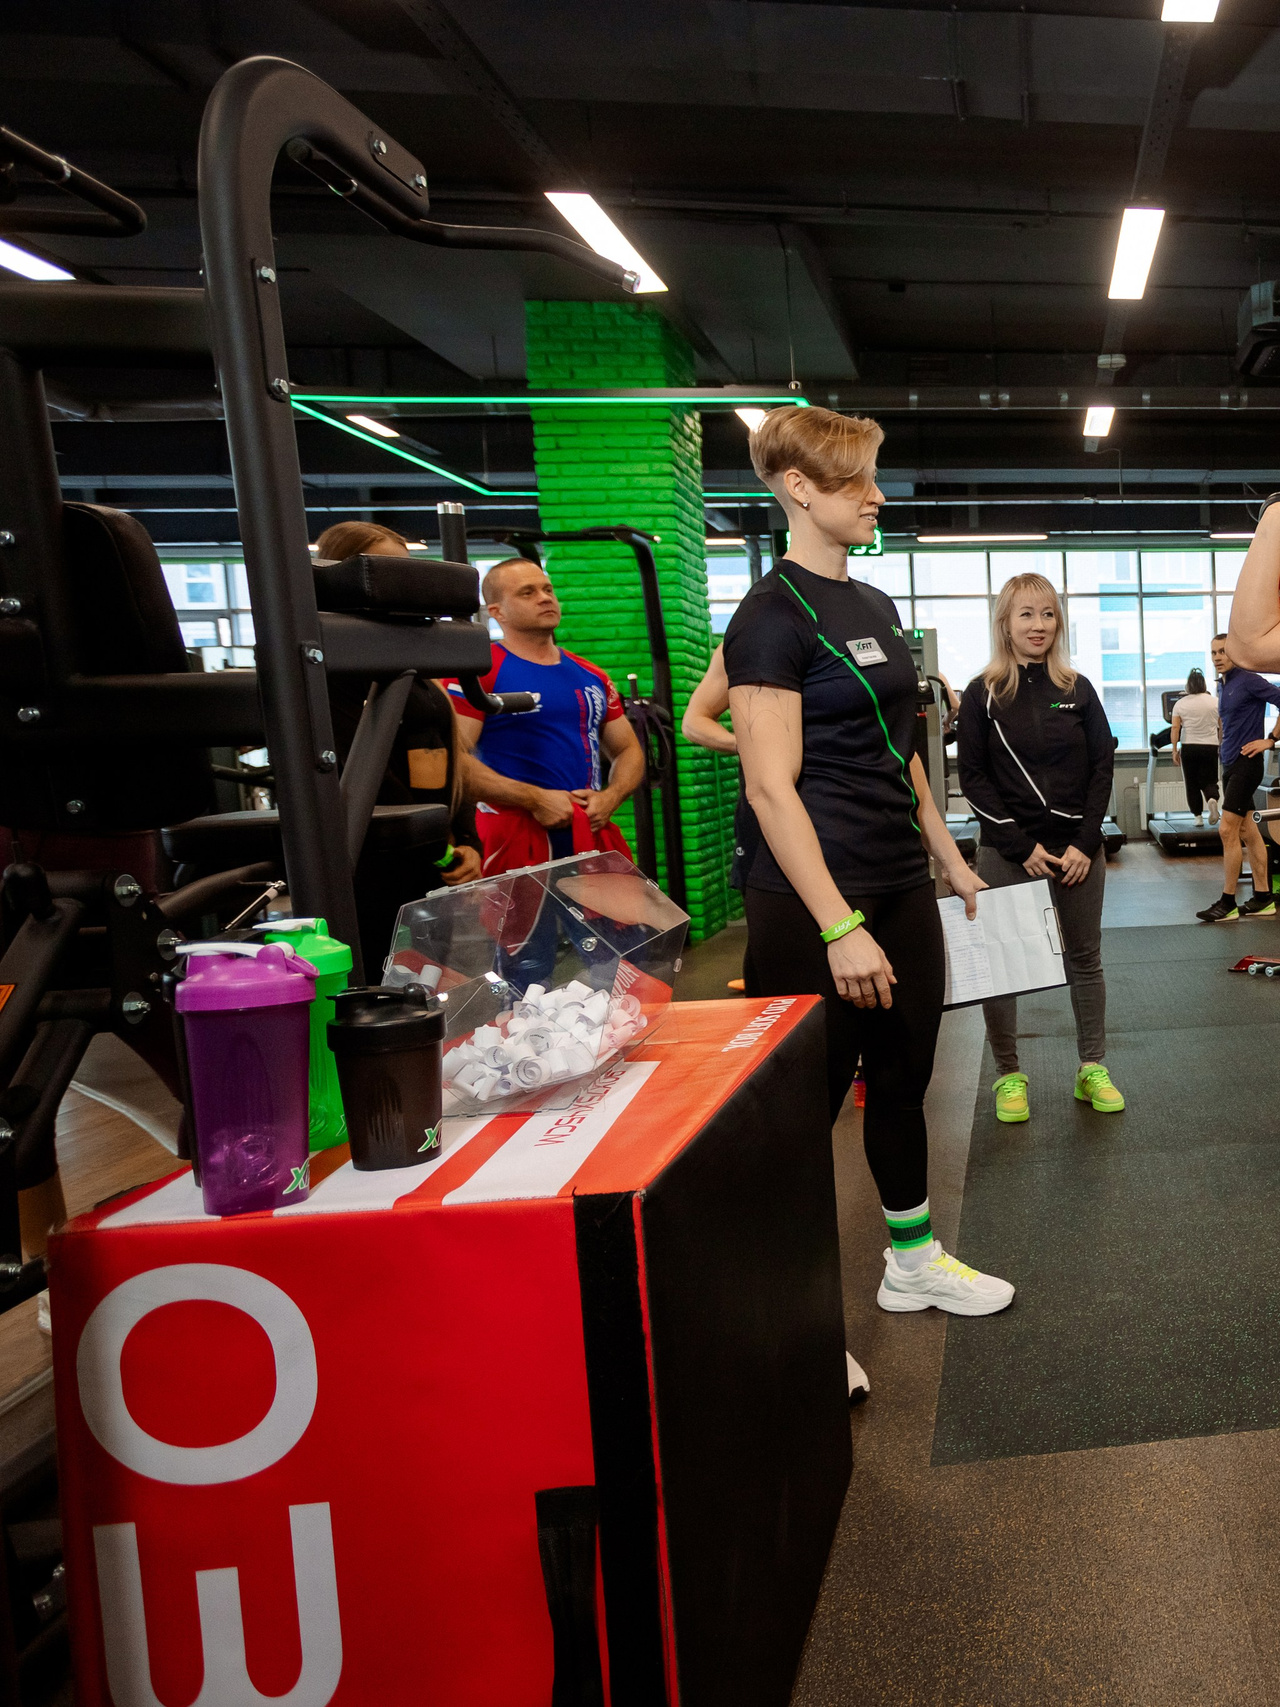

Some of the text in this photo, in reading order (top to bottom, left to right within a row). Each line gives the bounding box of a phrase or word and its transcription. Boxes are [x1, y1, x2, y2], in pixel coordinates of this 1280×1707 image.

[855, 641, 873, 651] XFIT
[761, 998, 797, 1015] PLYO
[742, 1014, 781, 1031] SOFT
